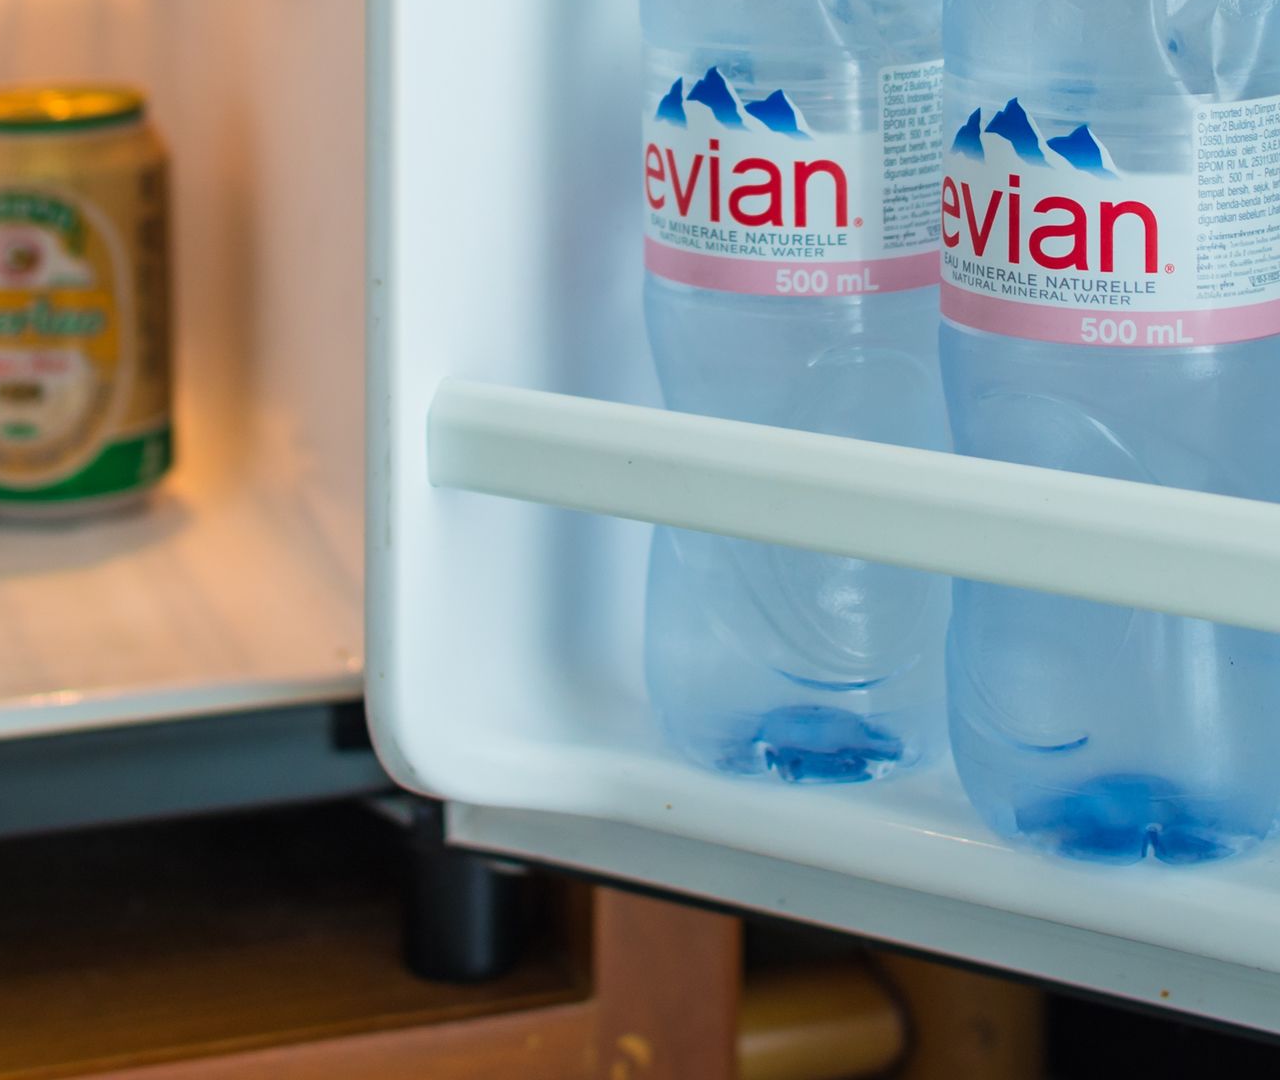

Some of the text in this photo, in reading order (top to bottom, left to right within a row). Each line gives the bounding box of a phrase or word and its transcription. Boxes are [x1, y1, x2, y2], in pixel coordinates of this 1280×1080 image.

[1198, 160, 1224, 173] BPOM
[1229, 171, 1243, 183] 500
[644, 138, 848, 228] evian
[668, 219, 737, 243] MINERALE
[745, 231, 848, 246] NATURELLE
[941, 174, 1159, 274] evian
[659, 231, 825, 258] NATURAL MINERAL WATER
[775, 266, 879, 294] 500 mL
[944, 251, 1156, 294] EAU MINERALE NATURELLE
[951, 270, 1131, 306] NATURAL MINERAL WATER
[1080, 317, 1194, 345] 500 mL
